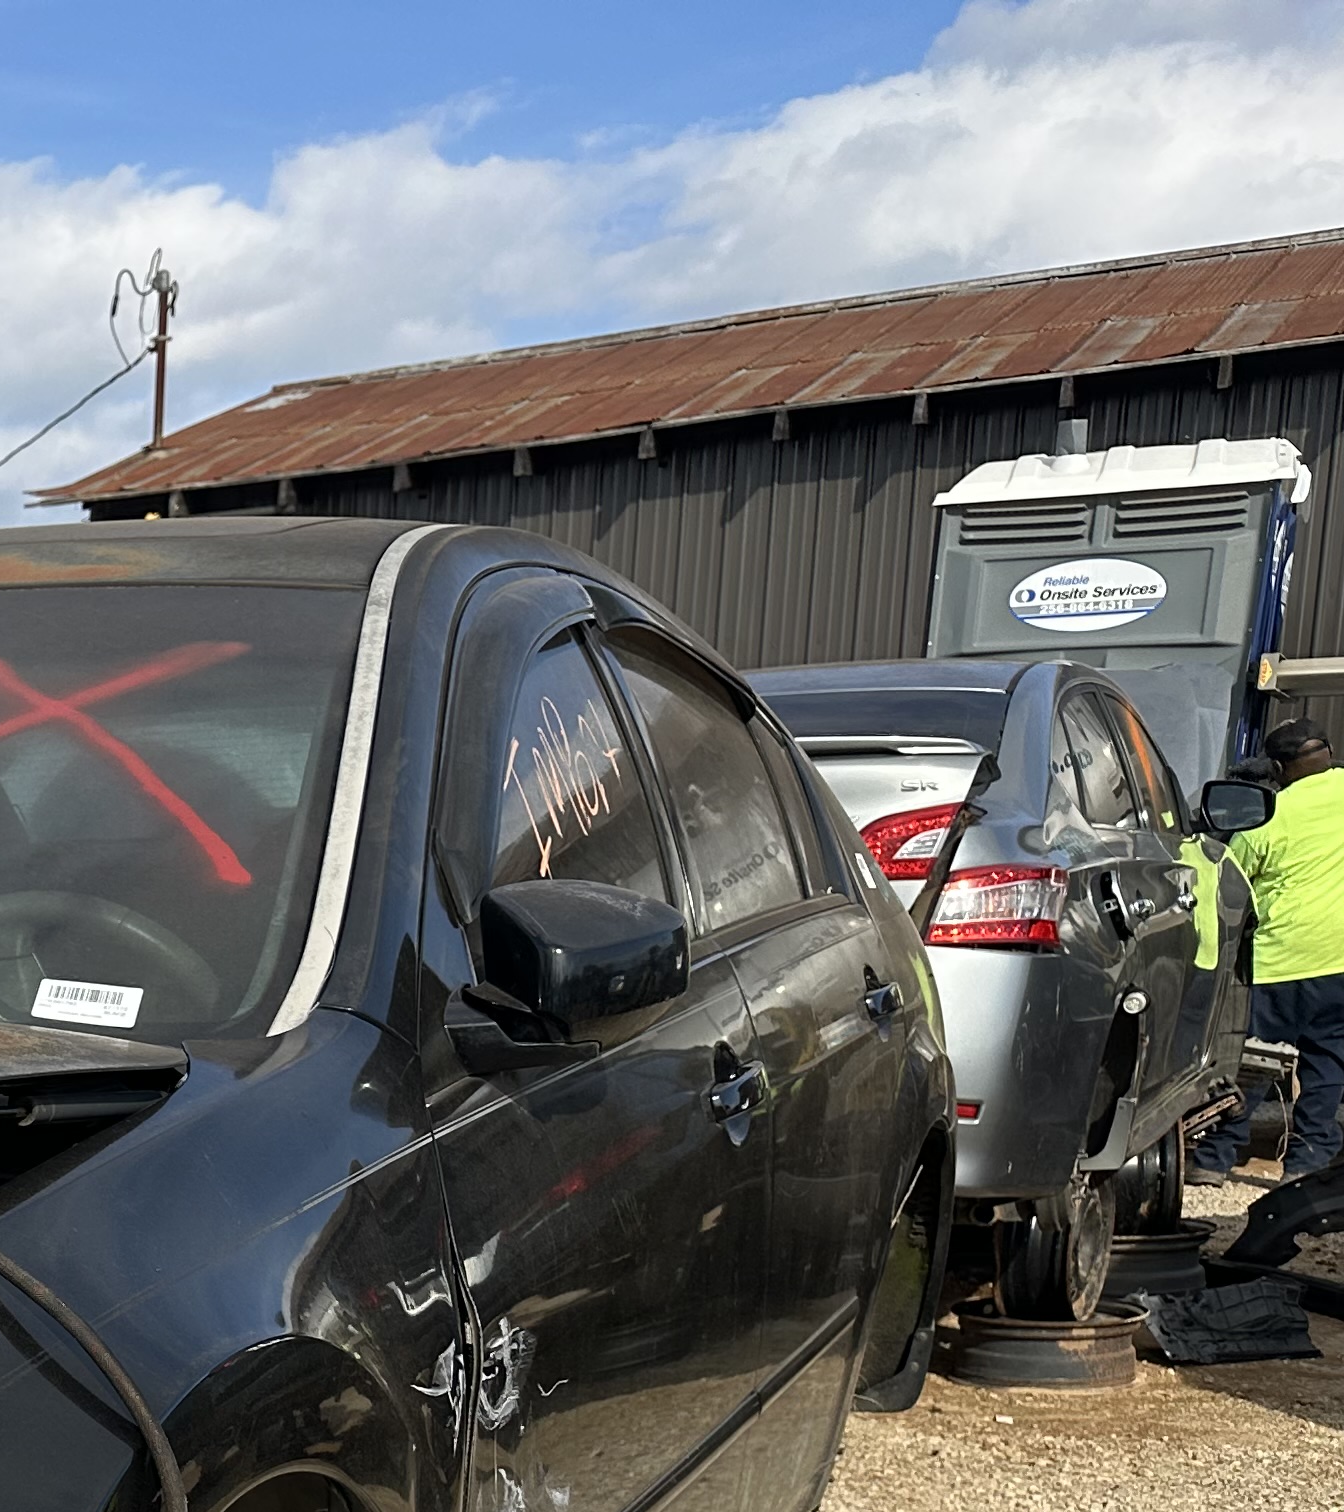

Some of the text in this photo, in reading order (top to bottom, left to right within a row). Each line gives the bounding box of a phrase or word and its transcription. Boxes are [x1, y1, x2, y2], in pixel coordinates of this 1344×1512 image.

[1043, 575, 1090, 587] Reliable
[1039, 583, 1158, 601] Onsite Services
